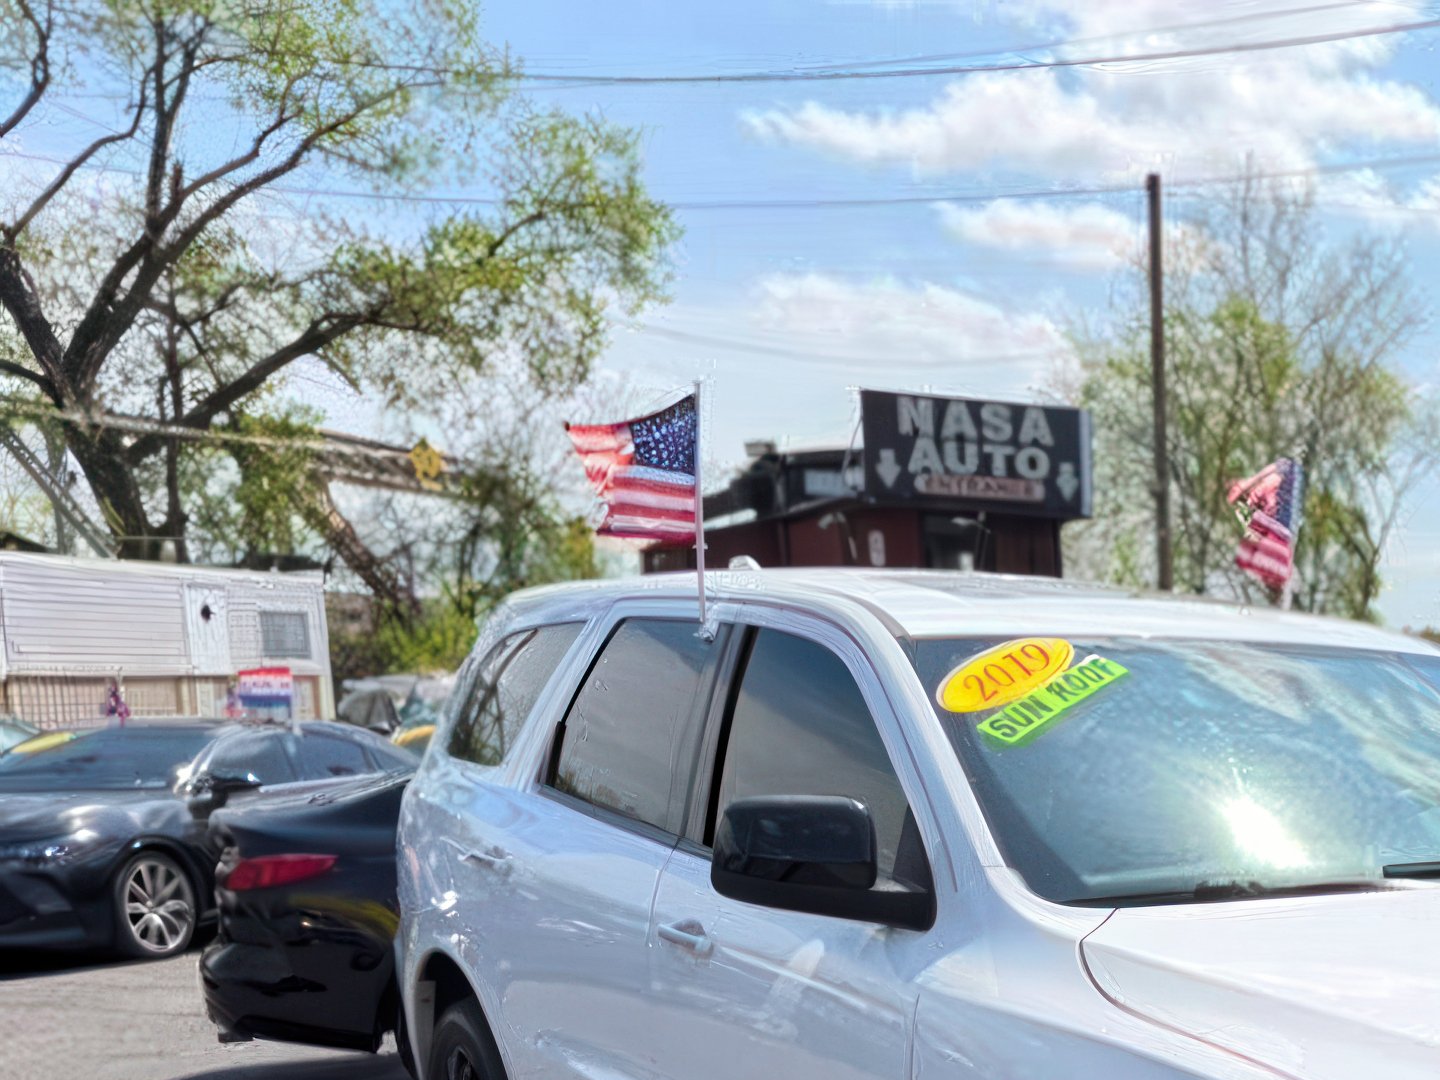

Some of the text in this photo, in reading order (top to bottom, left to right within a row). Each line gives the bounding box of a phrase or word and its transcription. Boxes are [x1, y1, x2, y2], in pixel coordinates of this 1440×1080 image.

[897, 396, 1054, 446] NASA
[908, 436, 1050, 480] AUTO
[963, 643, 1050, 701] 2019
[989, 695, 1053, 737] SUN
